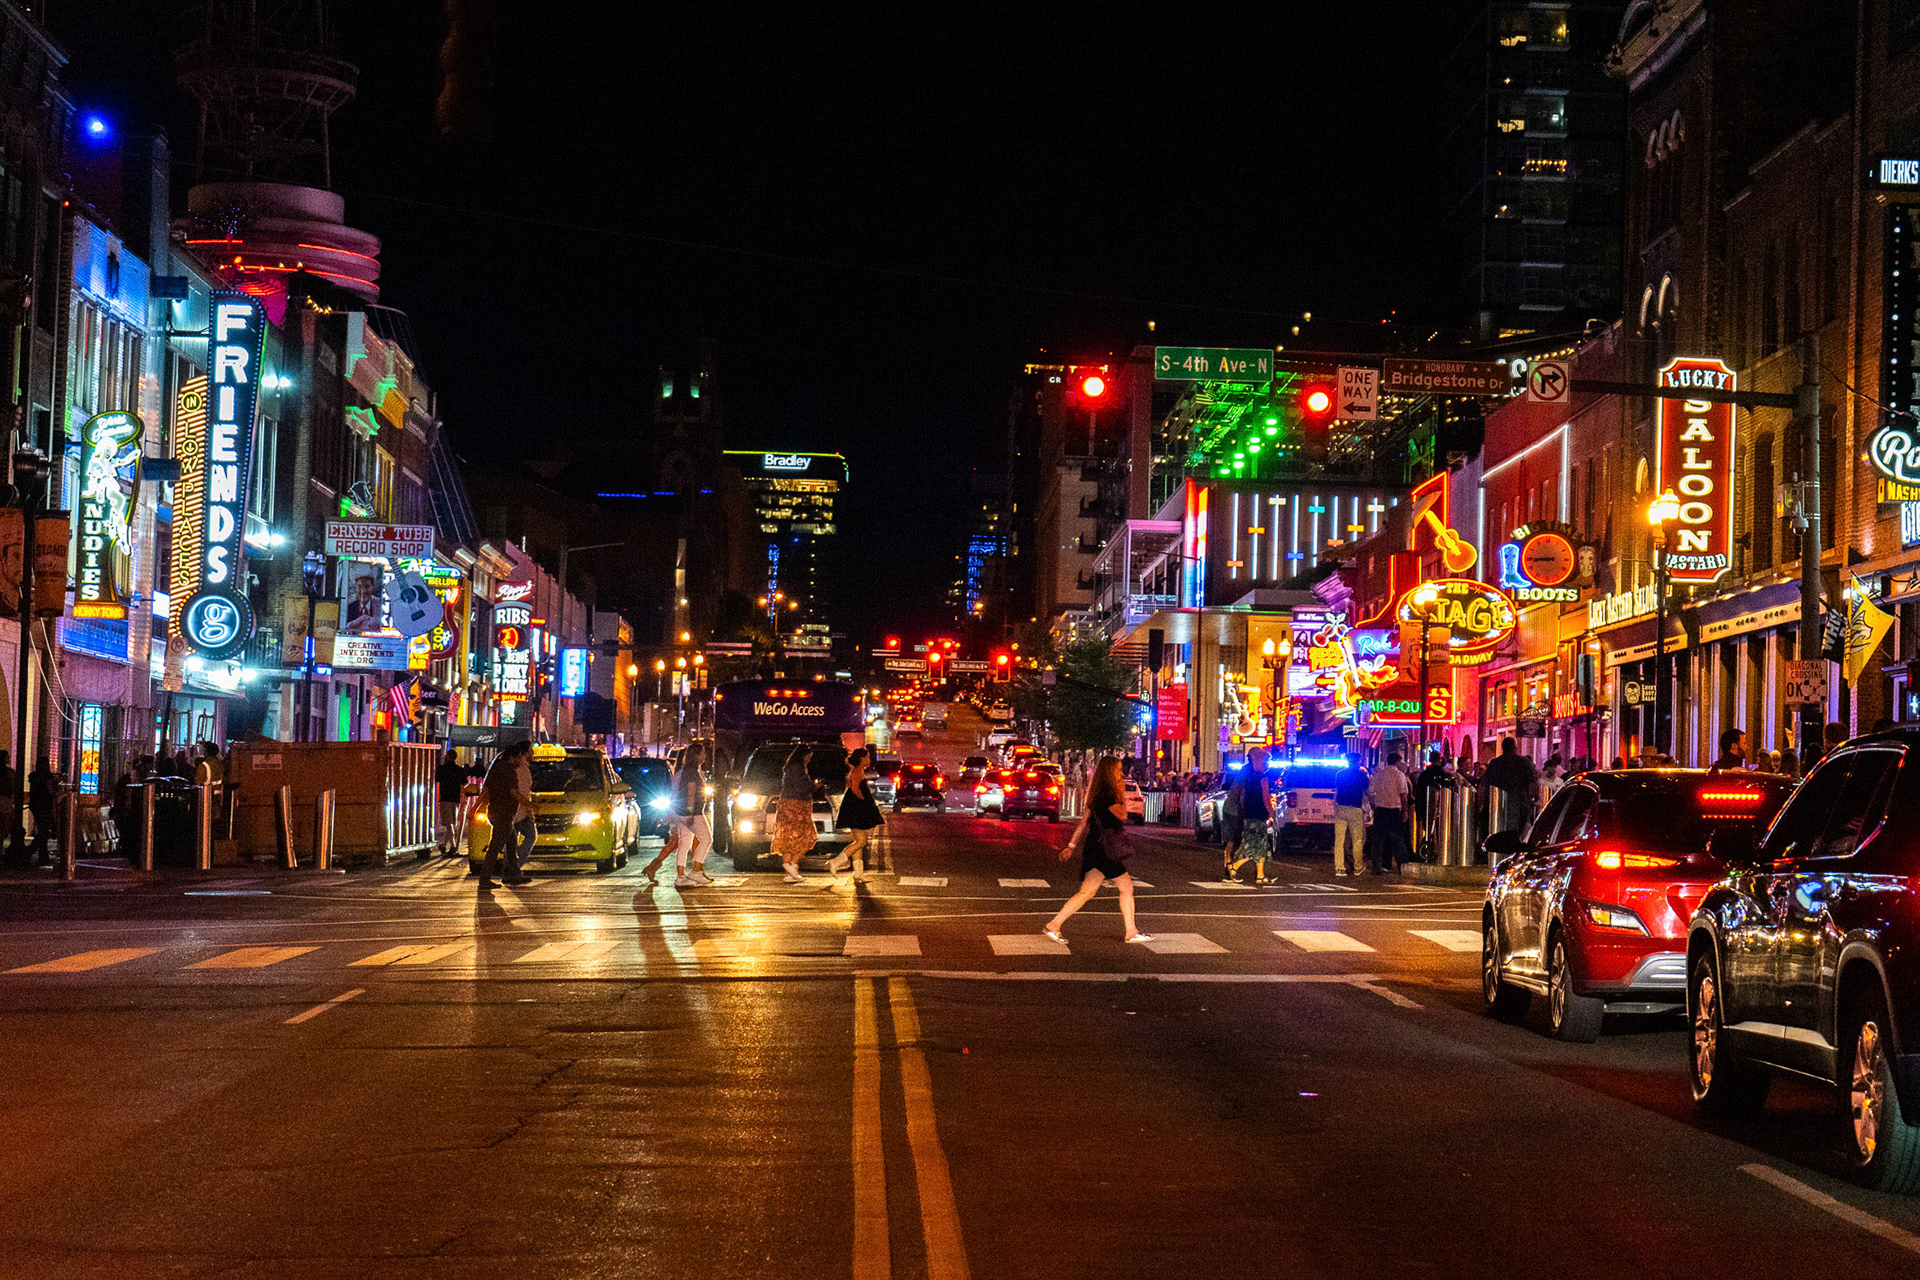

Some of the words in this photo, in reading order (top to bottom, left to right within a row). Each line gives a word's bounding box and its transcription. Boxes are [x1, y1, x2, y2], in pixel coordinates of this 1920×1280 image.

[1880, 160, 1920, 183] DIERKS
[1425, 363, 1465, 372] HONORARY
[1345, 371, 1372, 384] ONE
[1392, 372, 1486, 388] Bridgestone
[1490, 378, 1504, 389] Dr
[1666, 369, 1729, 390] LUCKY
[1343, 386, 1372, 398] WAY
[186, 396, 197, 408] IN
[208, 304, 252, 583] FRIENDS
[765, 453, 811, 469] Bradley
[178, 482, 194, 586] PLACES
[329, 524, 386, 539] ERNEST
[394, 527, 431, 541] TUBB
[82, 504, 104, 600] NUDIES
[336, 540, 386, 554] RECORD
[391, 543, 424, 556] SHOP
[1446, 582, 1469, 595] THE
[1517, 587, 1578, 601] BOOTS
[74, 607, 99, 617] HONKY
[101, 608, 122, 618] TONK
[497, 608, 530, 625] RIBS
[199, 603, 231, 642] g
[348, 641, 382, 649] CREATIVE
[1790, 662, 1822, 670] DIAGONAL
[1790, 671, 1822, 679] CROSSING
[1786, 682, 1803, 697] OK
[754, 702, 788, 715] WeGo
[790, 702, 825, 717] Access
[1358, 699, 1421, 713] BAR-B-QU
